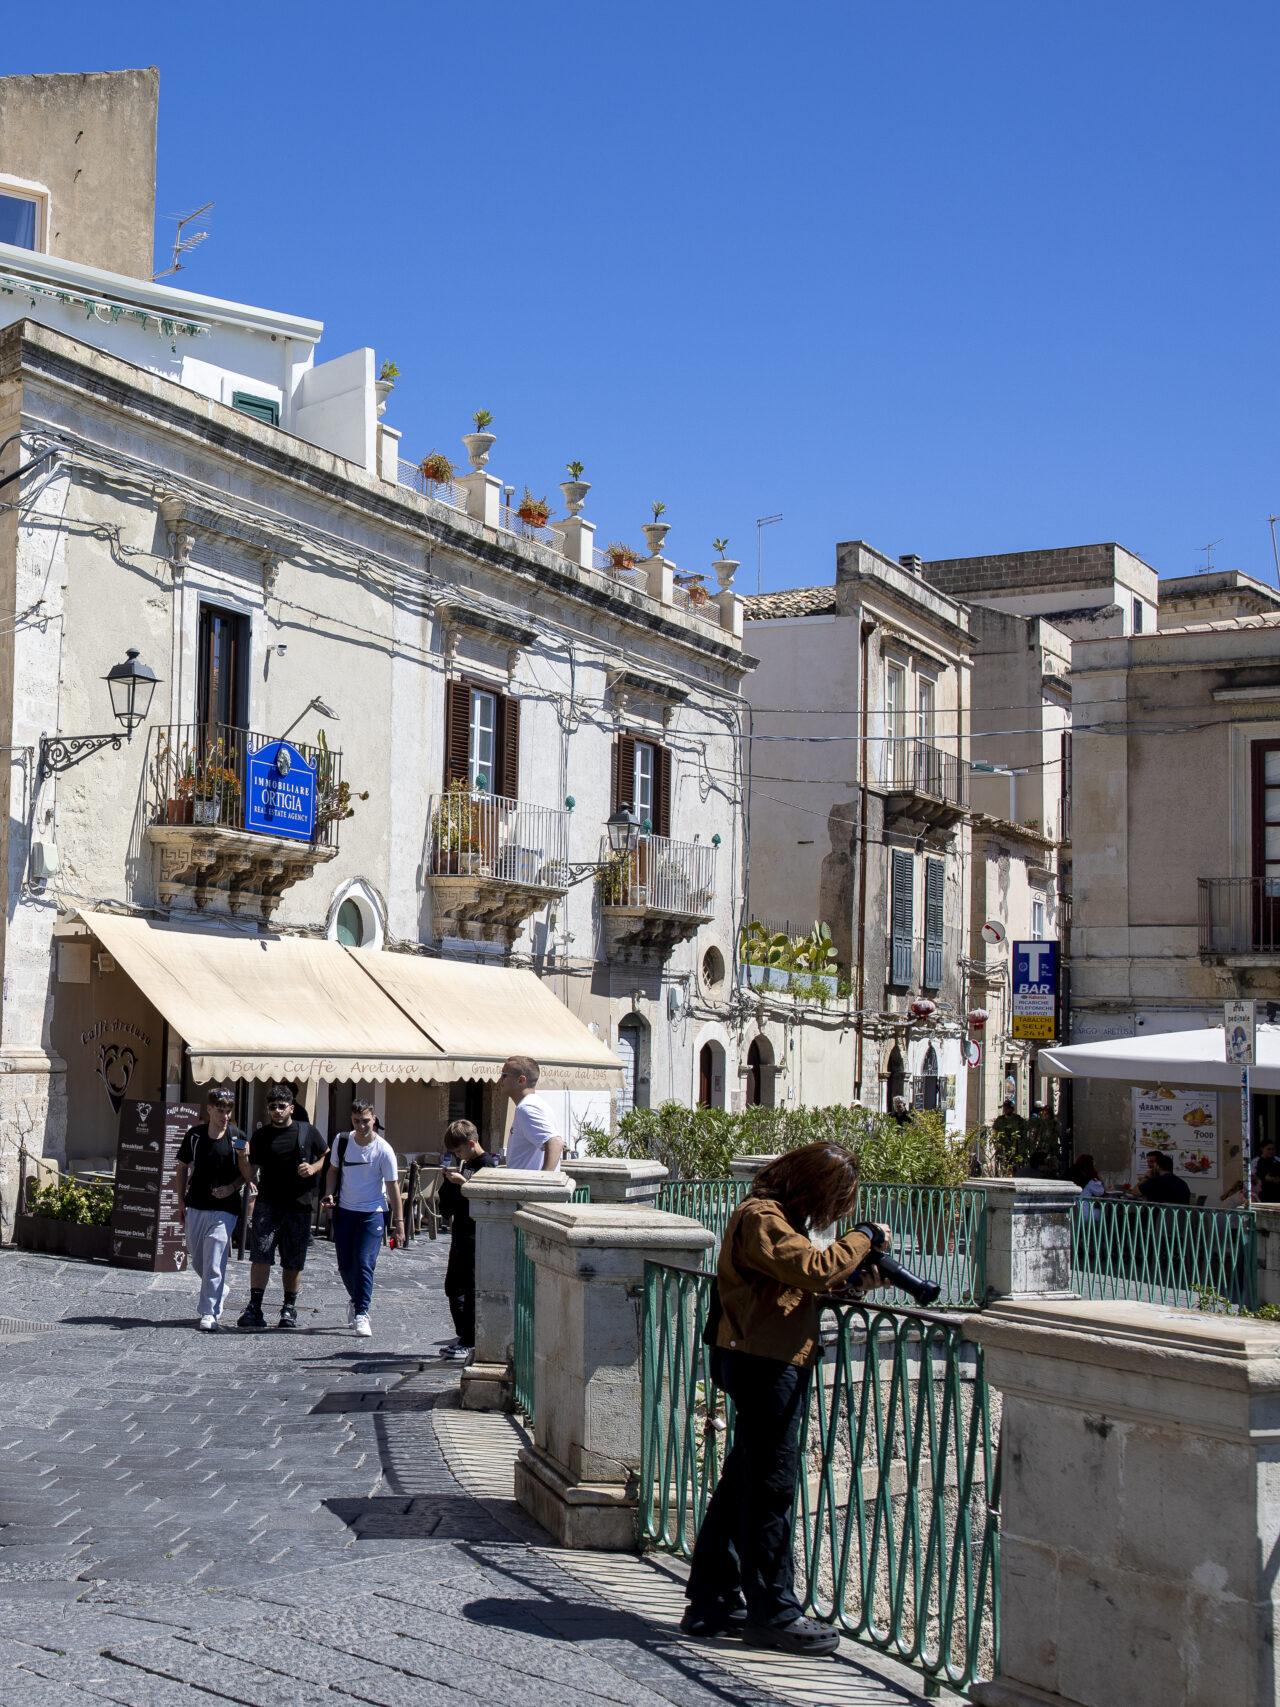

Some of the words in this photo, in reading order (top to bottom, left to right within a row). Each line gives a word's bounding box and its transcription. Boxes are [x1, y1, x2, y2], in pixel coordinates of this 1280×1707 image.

[254, 776, 310, 796] IMMOBILIARE
[261, 789, 302, 812] ORTIGIA
[254, 805, 267, 815] REAL
[268, 808, 286, 818] ESTATE
[287, 812, 308, 822] AGENCY
[1018, 983, 1050, 994] BAR
[1228, 1014, 1250, 1022] pednale
[230, 1060, 269, 1073] Bar
[283, 1060, 337, 1075] Caffè
[350, 1061, 420, 1074] Aretusa
[540, 1066, 570, 1078] Bianca
[574, 1067, 591, 1080] dal
